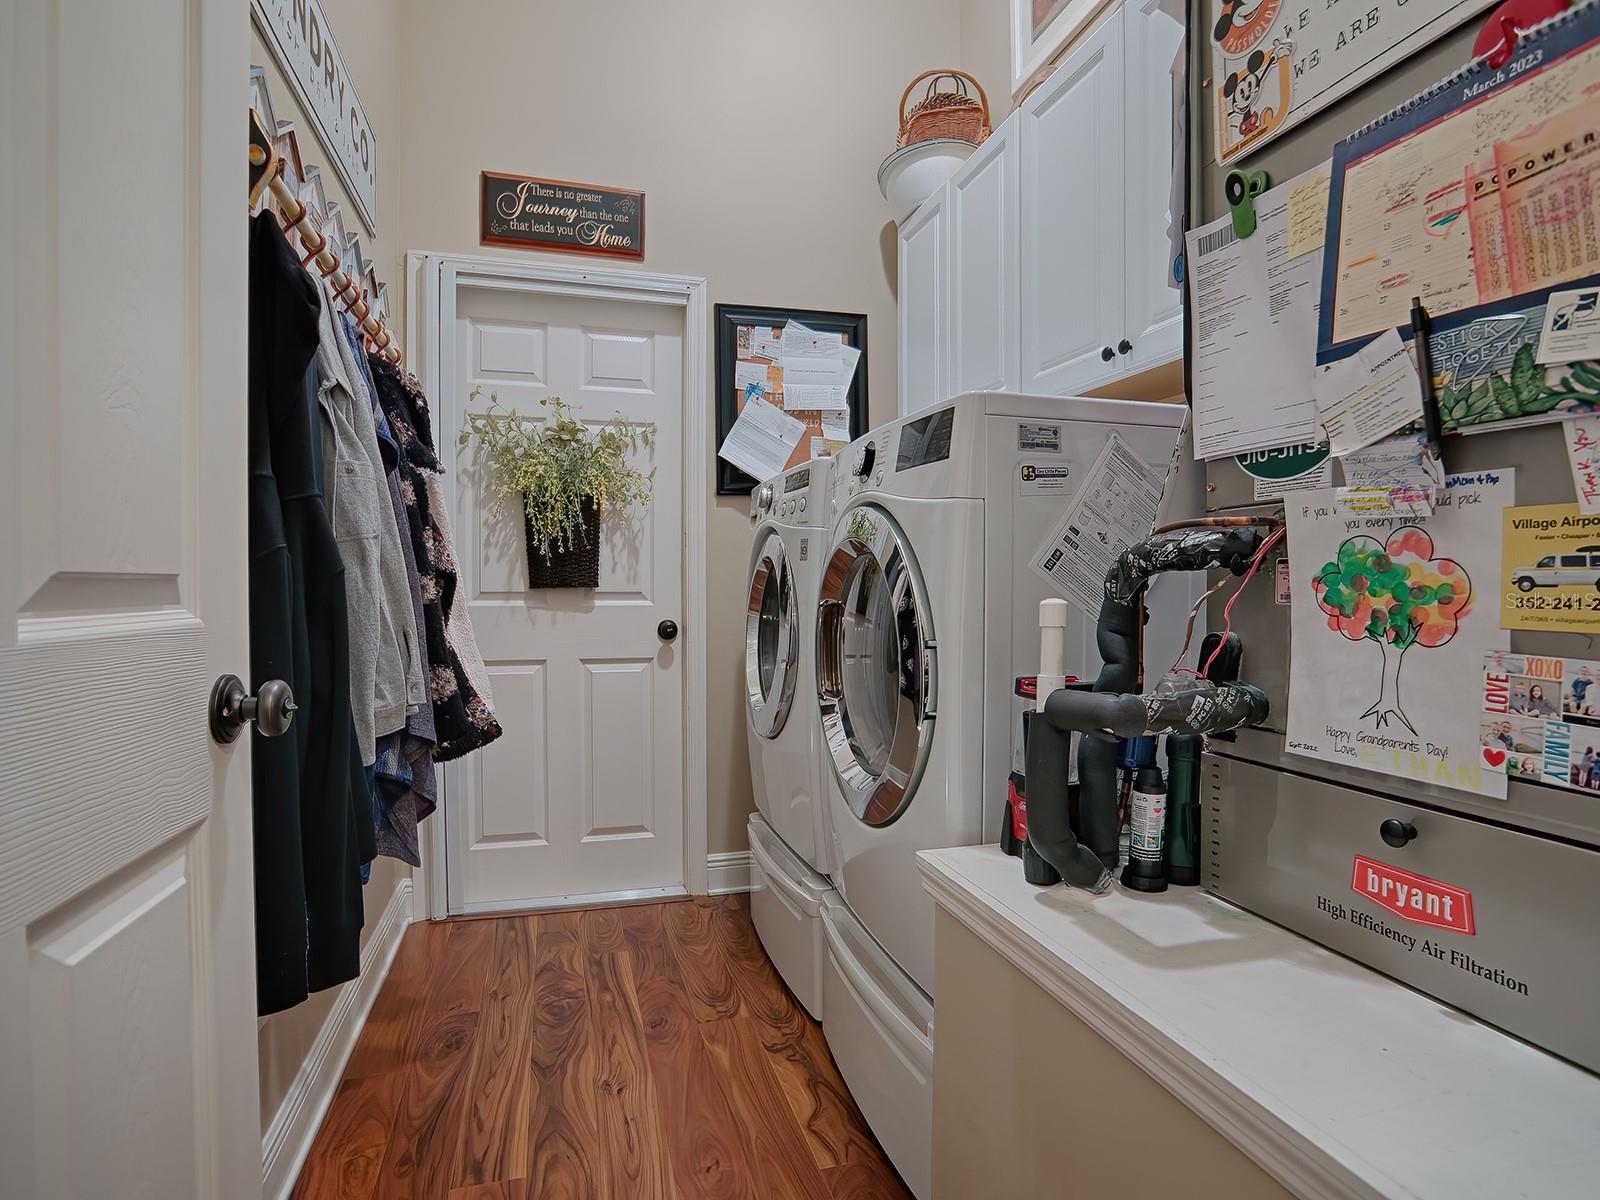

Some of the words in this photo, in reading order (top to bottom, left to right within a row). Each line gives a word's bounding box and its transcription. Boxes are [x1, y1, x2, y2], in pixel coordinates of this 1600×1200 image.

[1294, 49, 1319, 78] WE
[1335, 7, 1379, 51] ARE
[1463, 71, 1505, 100] March
[1508, 49, 1543, 77] 2023
[496, 182, 578, 223] Journey
[579, 207, 598, 220] than
[600, 210, 612, 221] the
[614, 213, 629, 223] one
[530, 184, 554, 198] There
[556, 188, 563, 198] is
[564, 190, 575, 199] no
[576, 191, 602, 203] greater
[510, 220, 530, 232] that
[532, 220, 555, 234] leads
[557, 225, 573, 237] you
[575, 221, 631, 248] Home
[1437, 320, 1499, 350] STICK
[1437, 333, 1537, 371] TOGETHE
[1314, 507, 1328, 520] you
[1458, 490, 1481, 509] pick
[1345, 519, 1360, 533] you
[1366, 517, 1394, 531] every
[1512, 519, 1558, 531] Village
[1526, 656, 1563, 680] XOXO
[1485, 672, 1509, 714] LOVE
[1325, 725, 1351, 743] Happy
[1356, 731, 1420, 753] Grandparents
[1426, 742, 1449, 761] Day!
[1544, 721, 1571, 784] FAMILY
[1359, 744, 1482, 790] ETHAN
[1366, 867, 1453, 921] bryant
[1317, 895, 1347, 920] High
[1350, 909, 1417, 951] Efficiency
[1421, 939, 1446, 961] Air
[1450, 949, 1529, 996] Filtration
